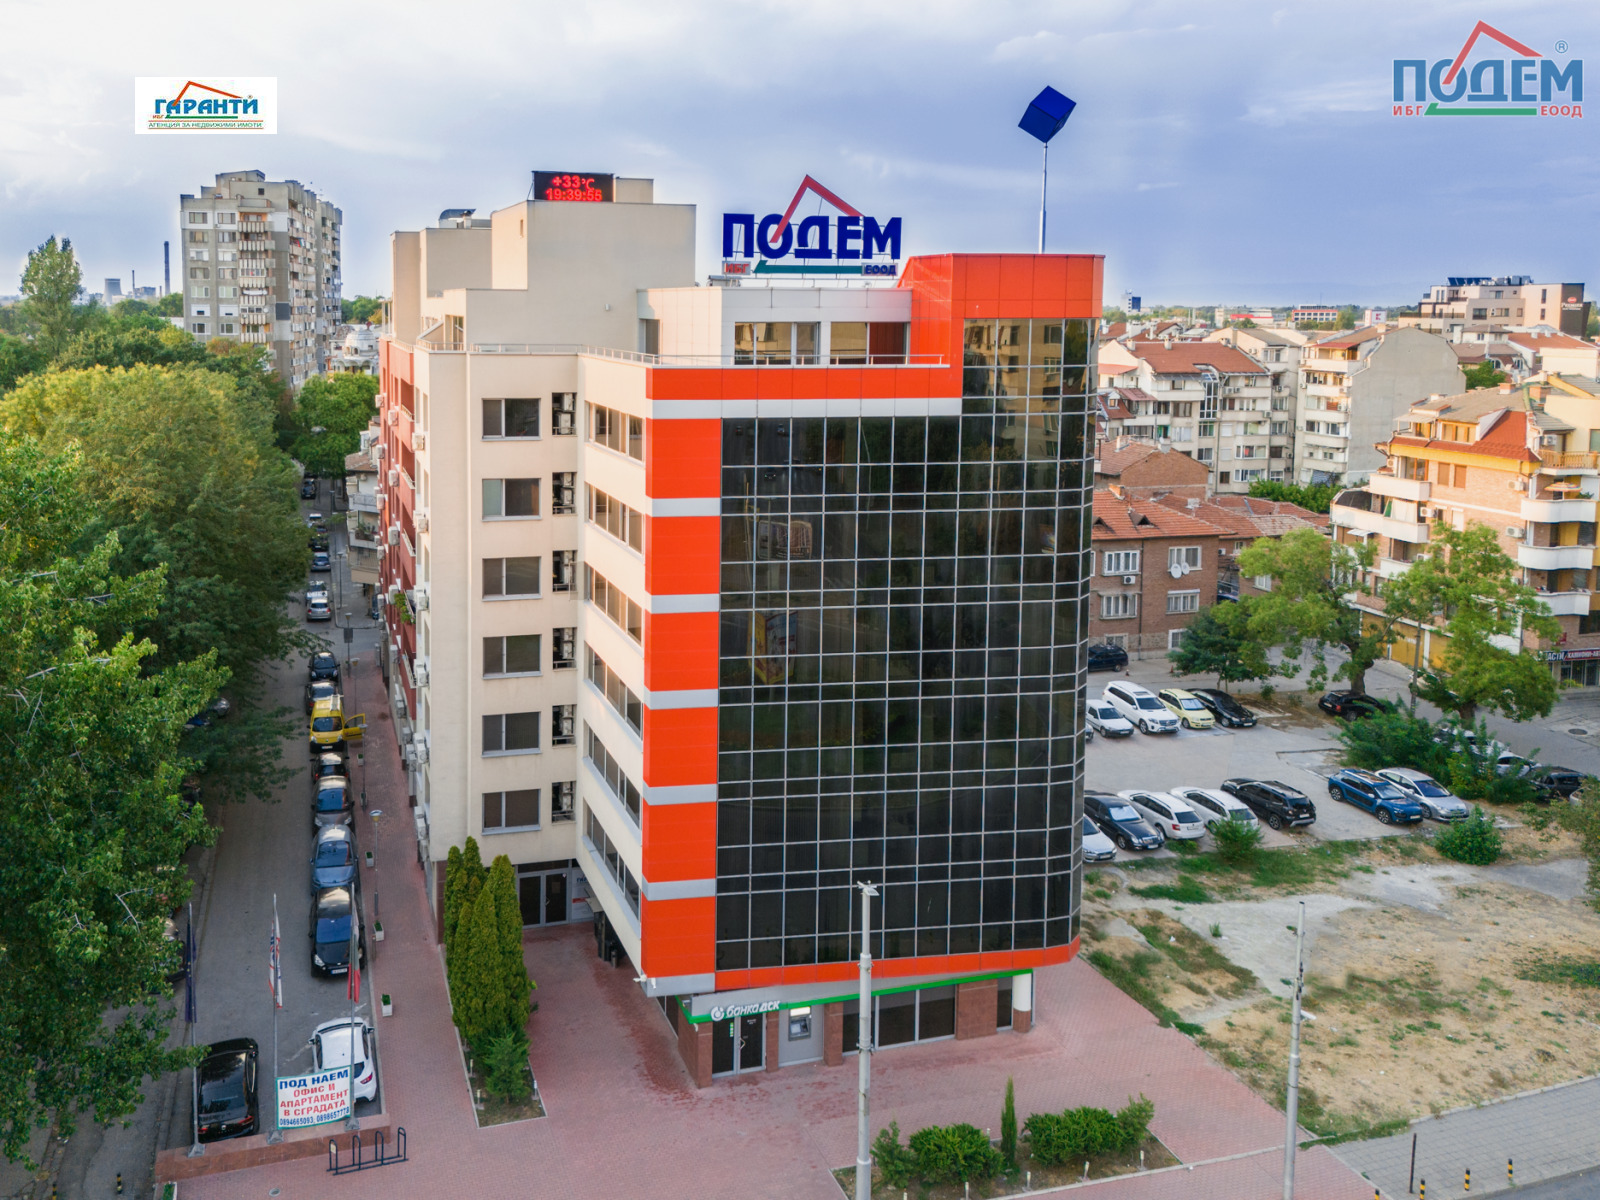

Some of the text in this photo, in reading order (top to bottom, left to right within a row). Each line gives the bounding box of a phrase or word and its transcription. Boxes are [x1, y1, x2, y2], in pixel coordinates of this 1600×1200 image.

[545, 188, 602, 202] 19:39:55
[723, 213, 902, 259] ПОДЕМ
[725, 263, 749, 274] ИБГ
[864, 264, 897, 276] ЕООД
[280, 1069, 349, 1090] ПОД НАЕМ
[280, 1088, 349, 1108] АПАРТАМЕНТ
[293, 1083, 336, 1098] ОФИС И
[293, 1099, 345, 1116] СГРАДАТА
